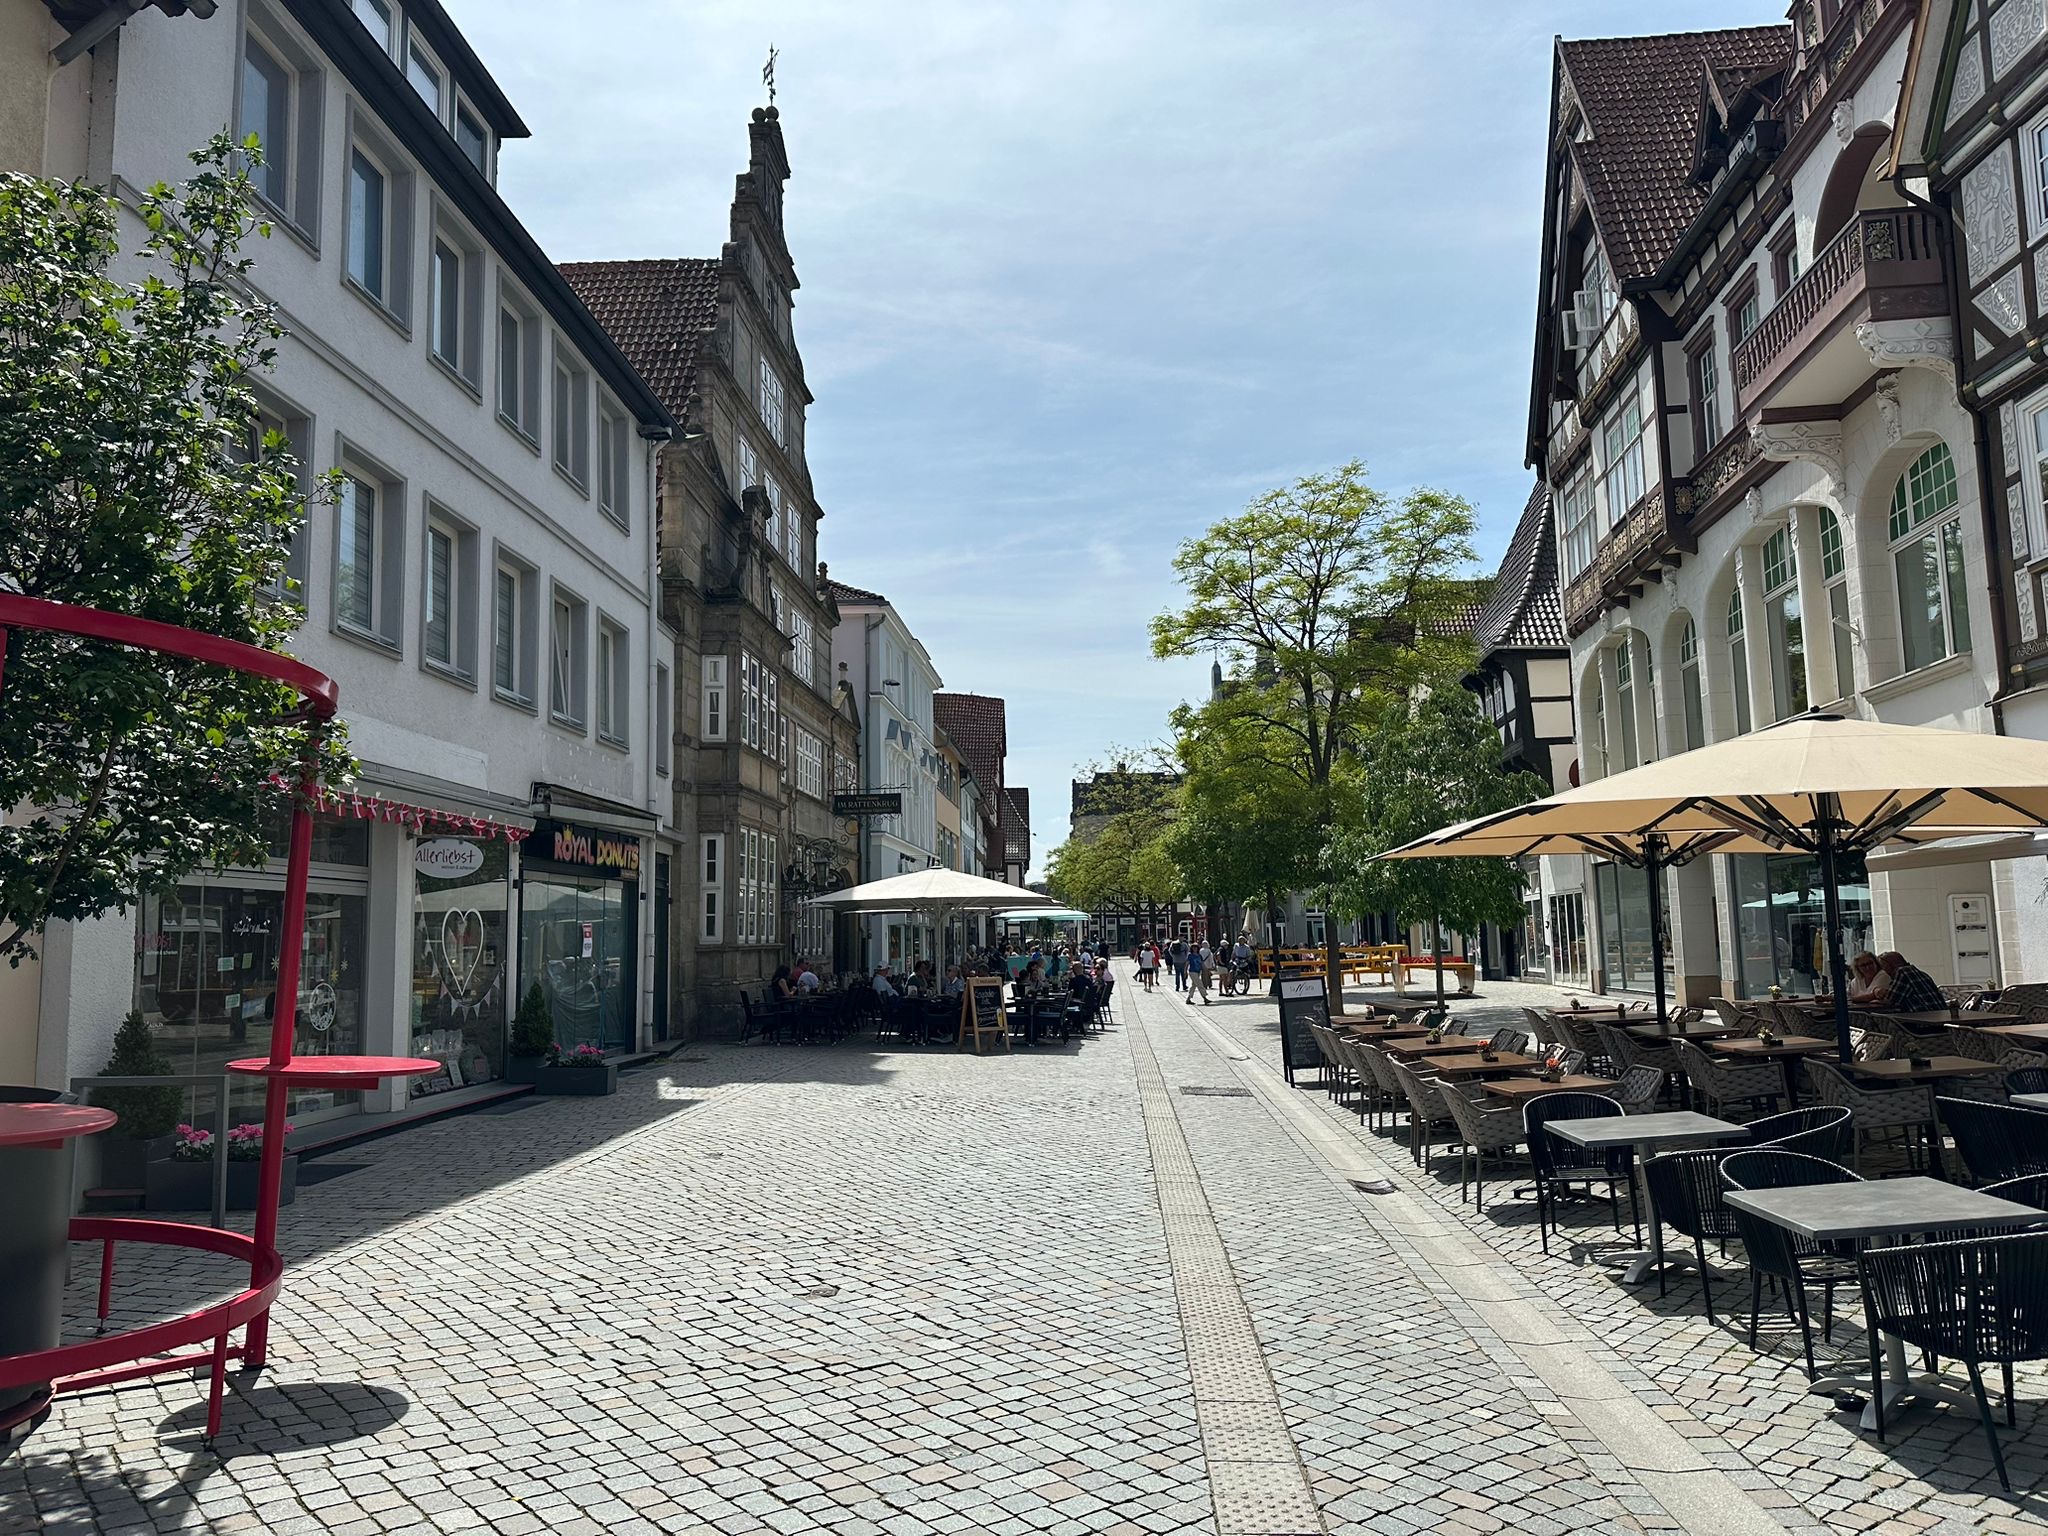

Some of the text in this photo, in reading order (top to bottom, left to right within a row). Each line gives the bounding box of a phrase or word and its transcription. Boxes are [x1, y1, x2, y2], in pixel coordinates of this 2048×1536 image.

[848, 799, 898, 809] RATTENKRUG
[415, 848, 476, 865] allerliebst
[554, 831, 639, 871] ROYAL DONUTS
